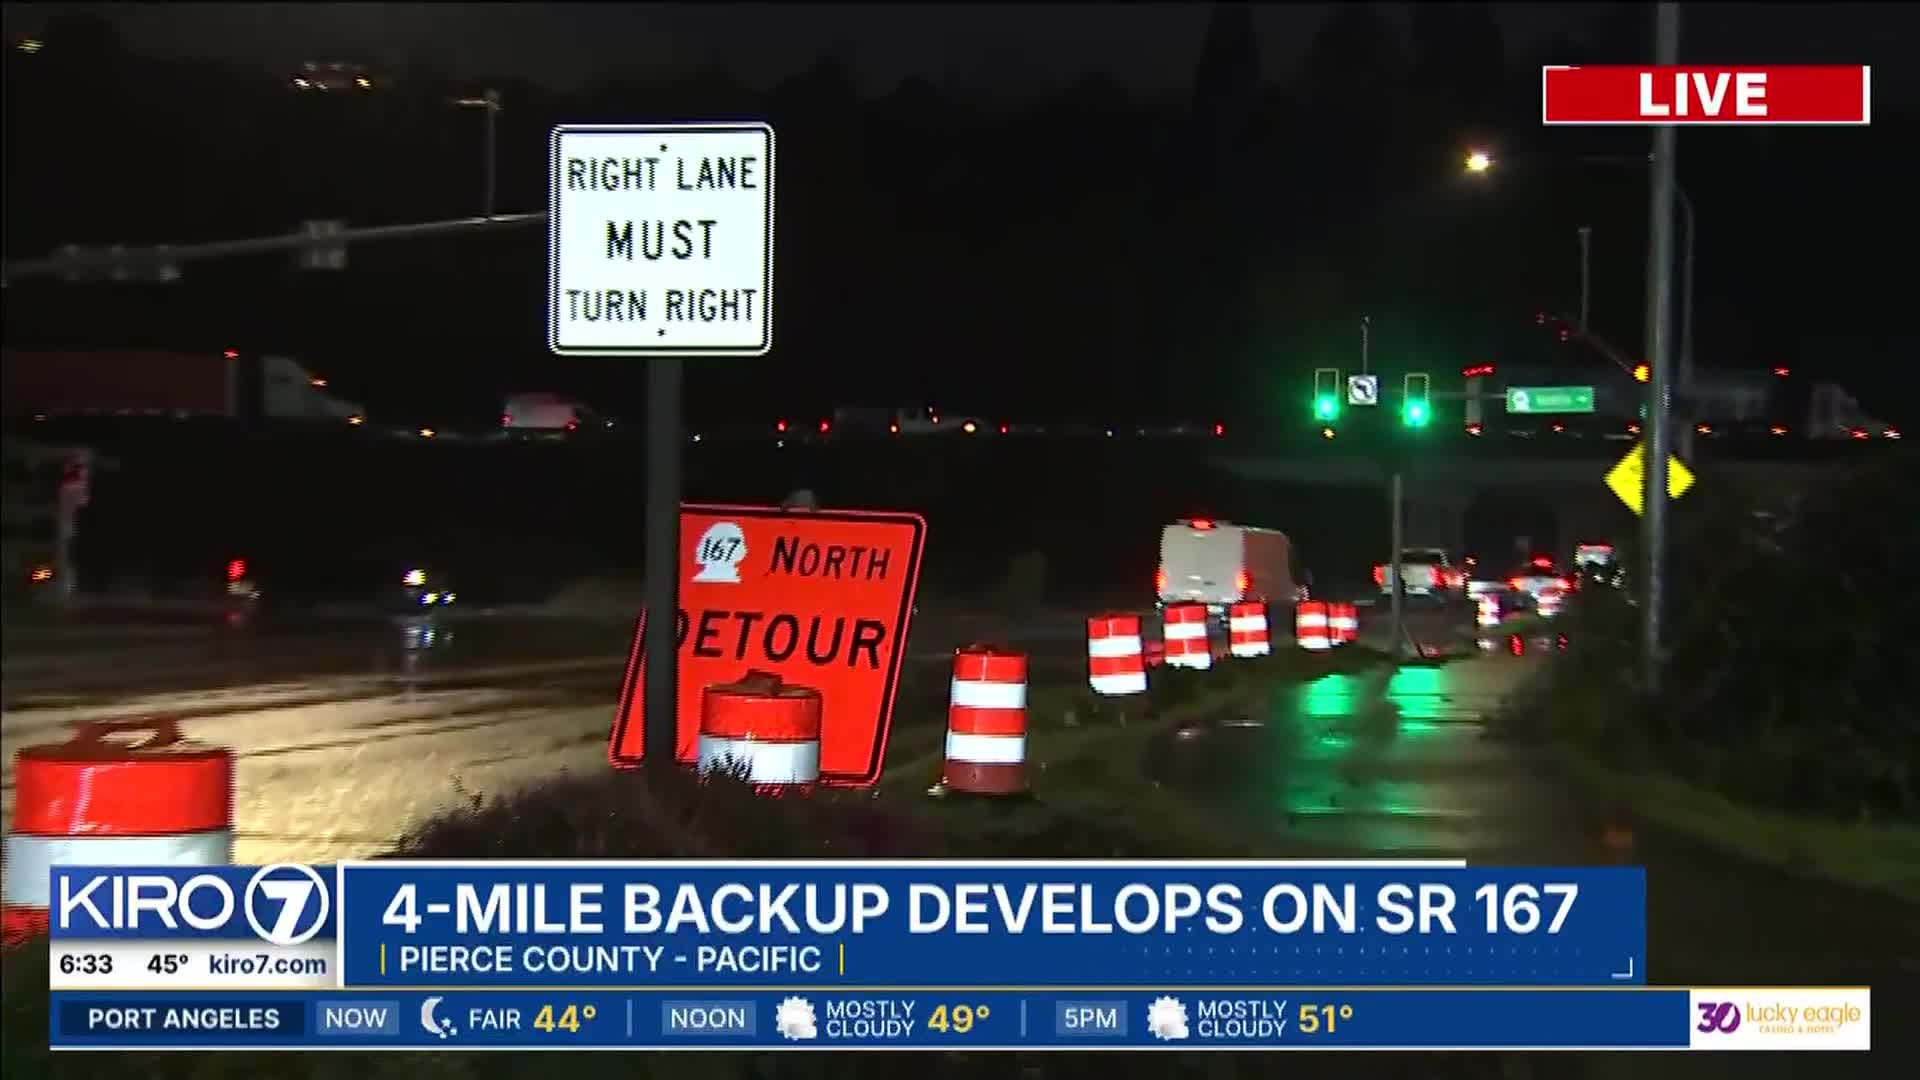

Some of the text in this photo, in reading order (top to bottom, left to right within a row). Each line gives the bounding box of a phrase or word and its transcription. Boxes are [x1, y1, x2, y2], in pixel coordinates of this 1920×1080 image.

[568, 157, 756, 191] RIGHT LANE
[607, 220, 716, 260] MUST
[567, 289, 756, 321] TURN RIGHT
[701, 537, 889, 577] 167 NORTH
